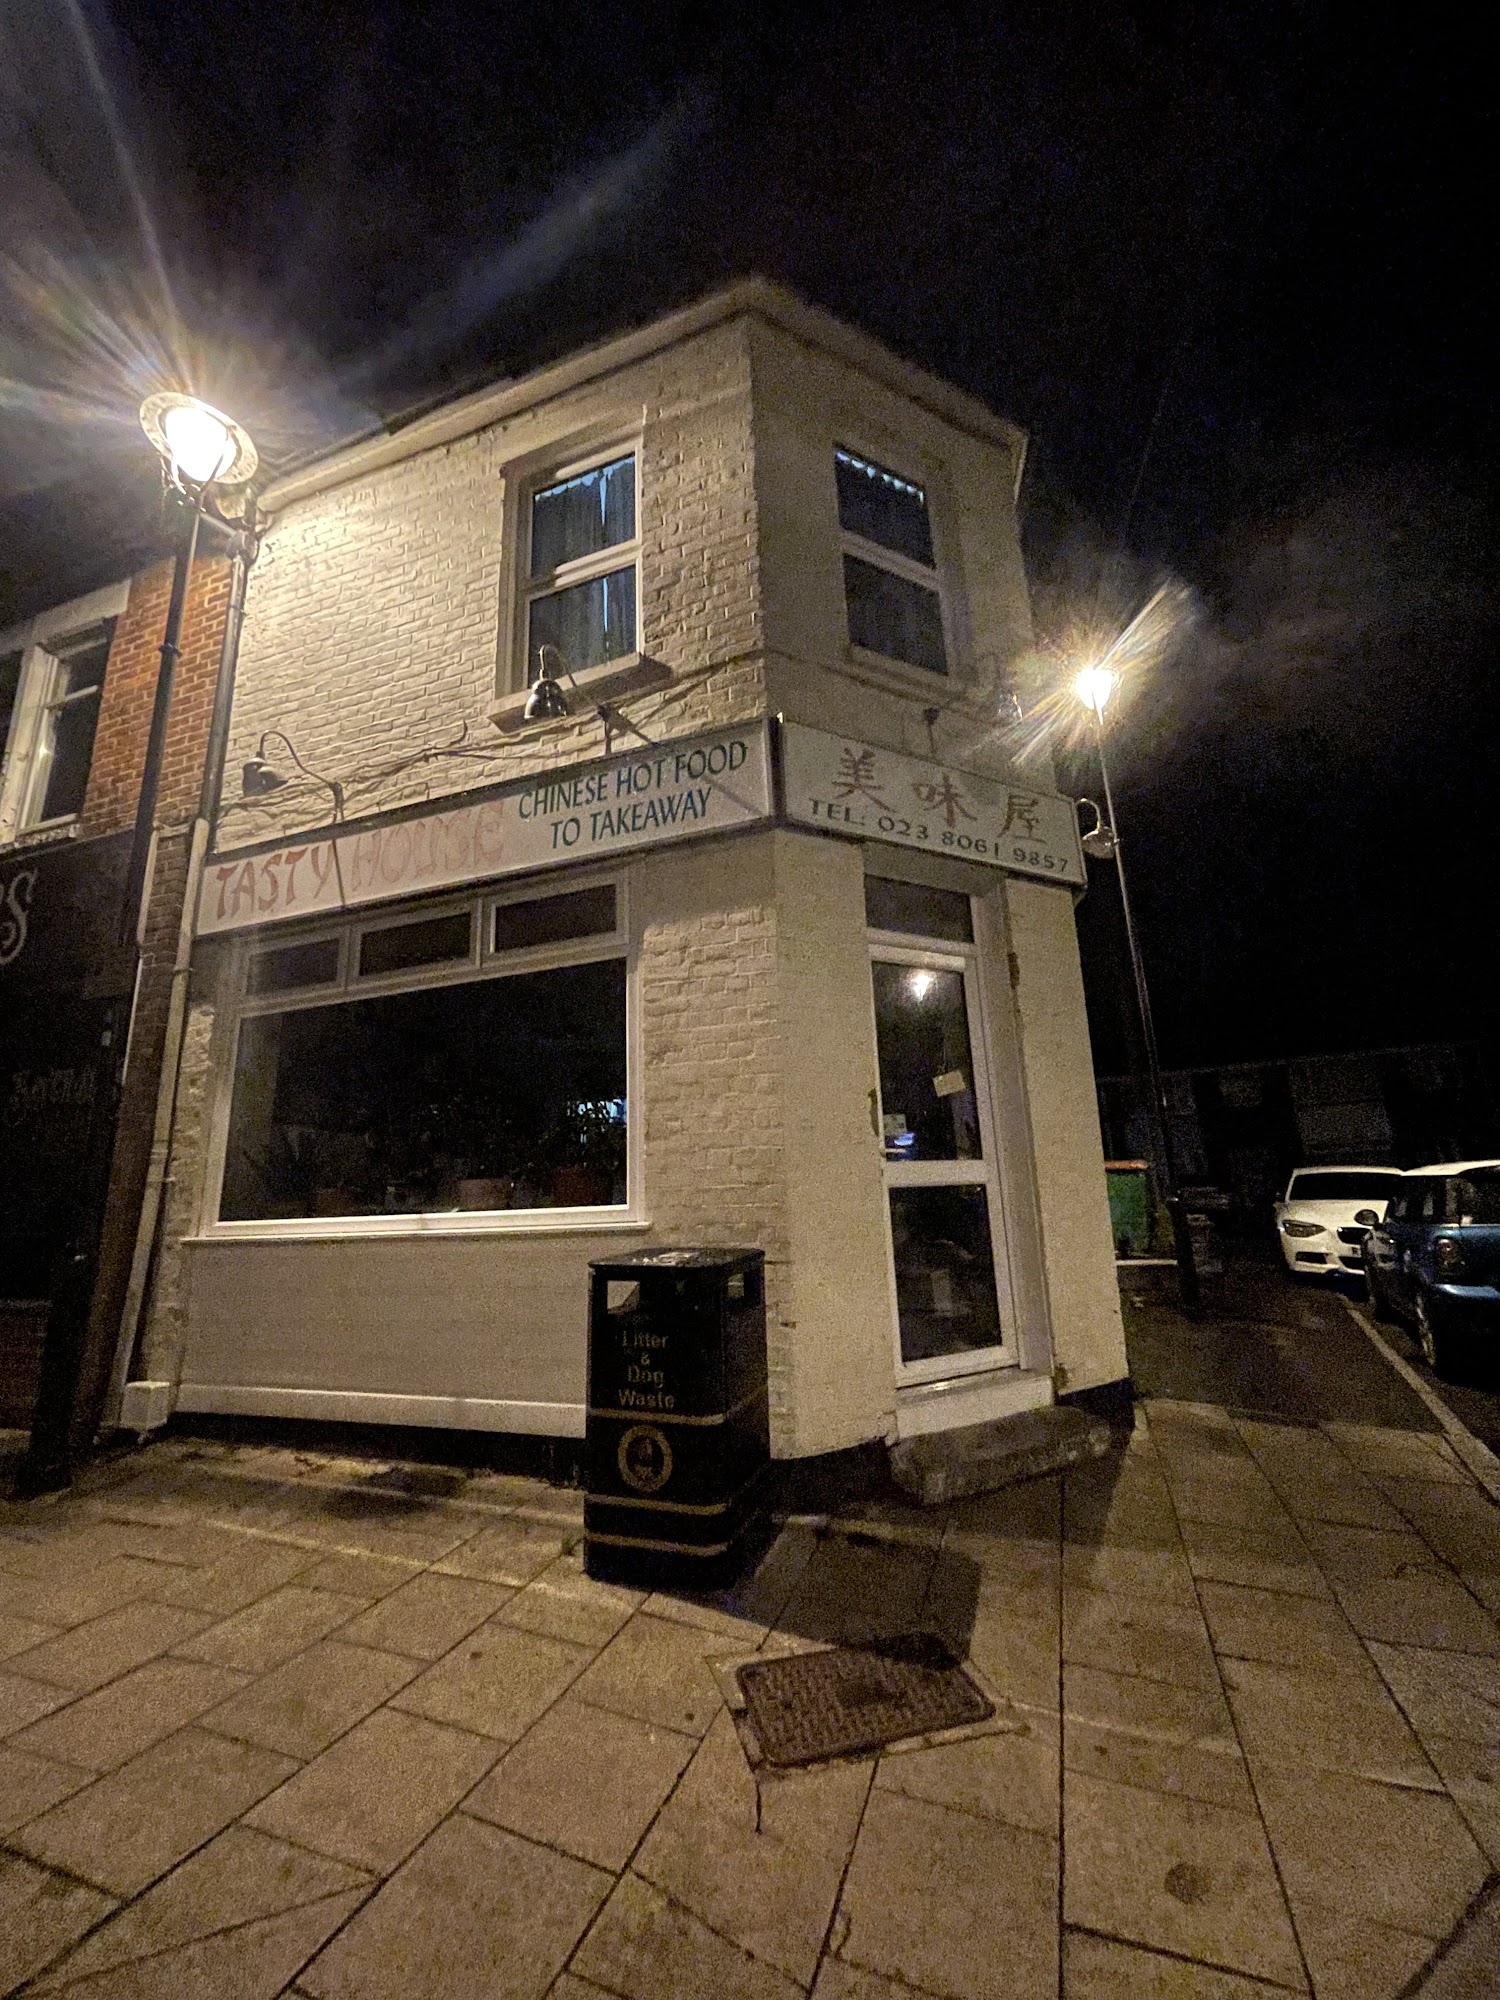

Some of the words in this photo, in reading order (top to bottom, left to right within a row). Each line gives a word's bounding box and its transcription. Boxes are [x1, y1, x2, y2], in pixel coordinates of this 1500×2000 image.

[519, 773, 608, 819] CHINESE
[616, 758, 668, 798] HOT
[675, 740, 748, 783] FOOD
[832, 748, 1046, 844] 美味屋
[551, 817, 581, 848] TO
[590, 787, 712, 842] TAKEAWAY
[878, 815, 929, 840] 023
[941, 830, 999, 861] 8061
[1013, 847, 1069, 873] 9857
[216, 842, 334, 920] TASTY
[350, 800, 504, 892] HOUSE
[622, 1329, 669, 1348] Litter
[618, 1388, 675, 1410] Waste
[627, 1364, 665, 1389] Dog
